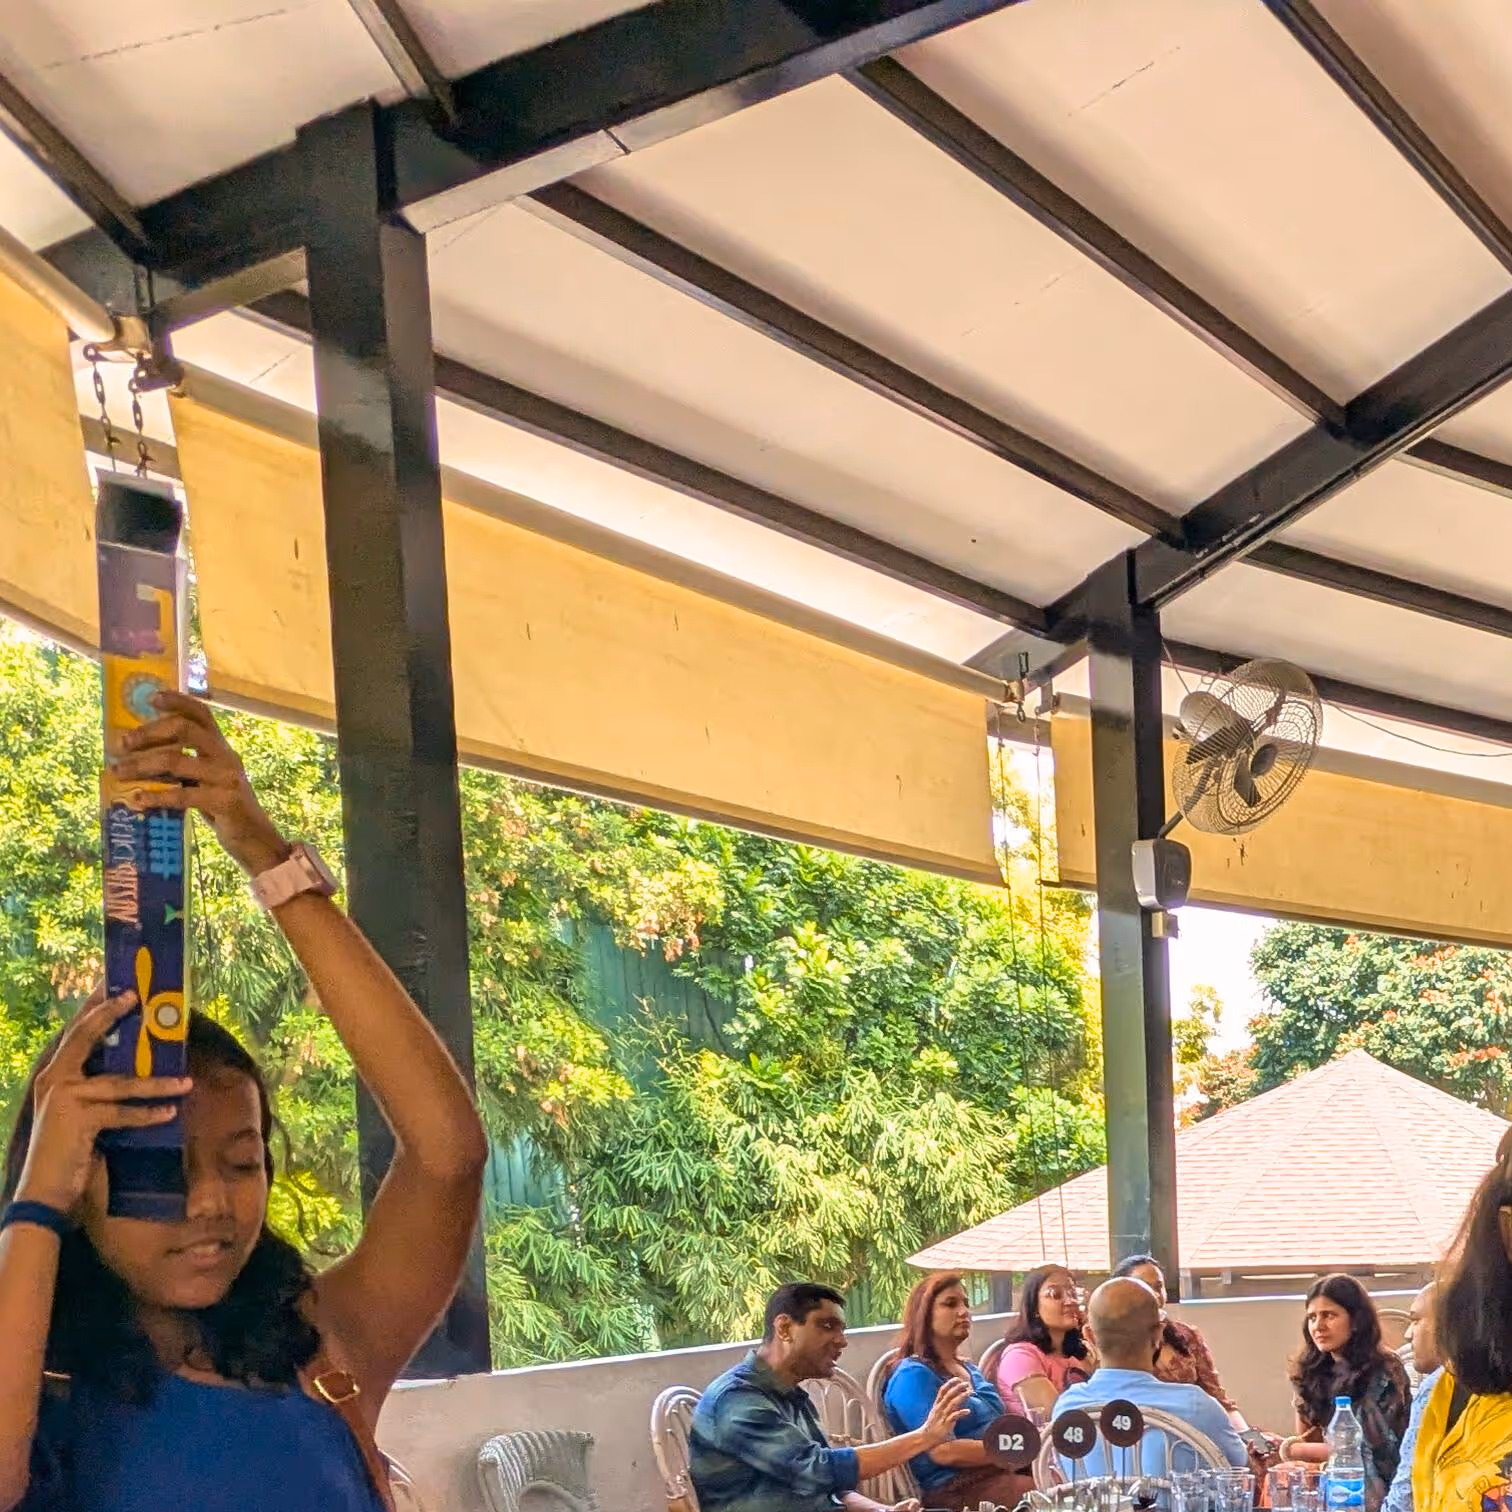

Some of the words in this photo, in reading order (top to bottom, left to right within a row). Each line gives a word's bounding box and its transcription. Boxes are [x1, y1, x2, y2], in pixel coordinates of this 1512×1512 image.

[1112, 1414, 1131, 1431] 49
[998, 1434, 1024, 1450] D2
[1063, 1426, 1084, 1443] 48
